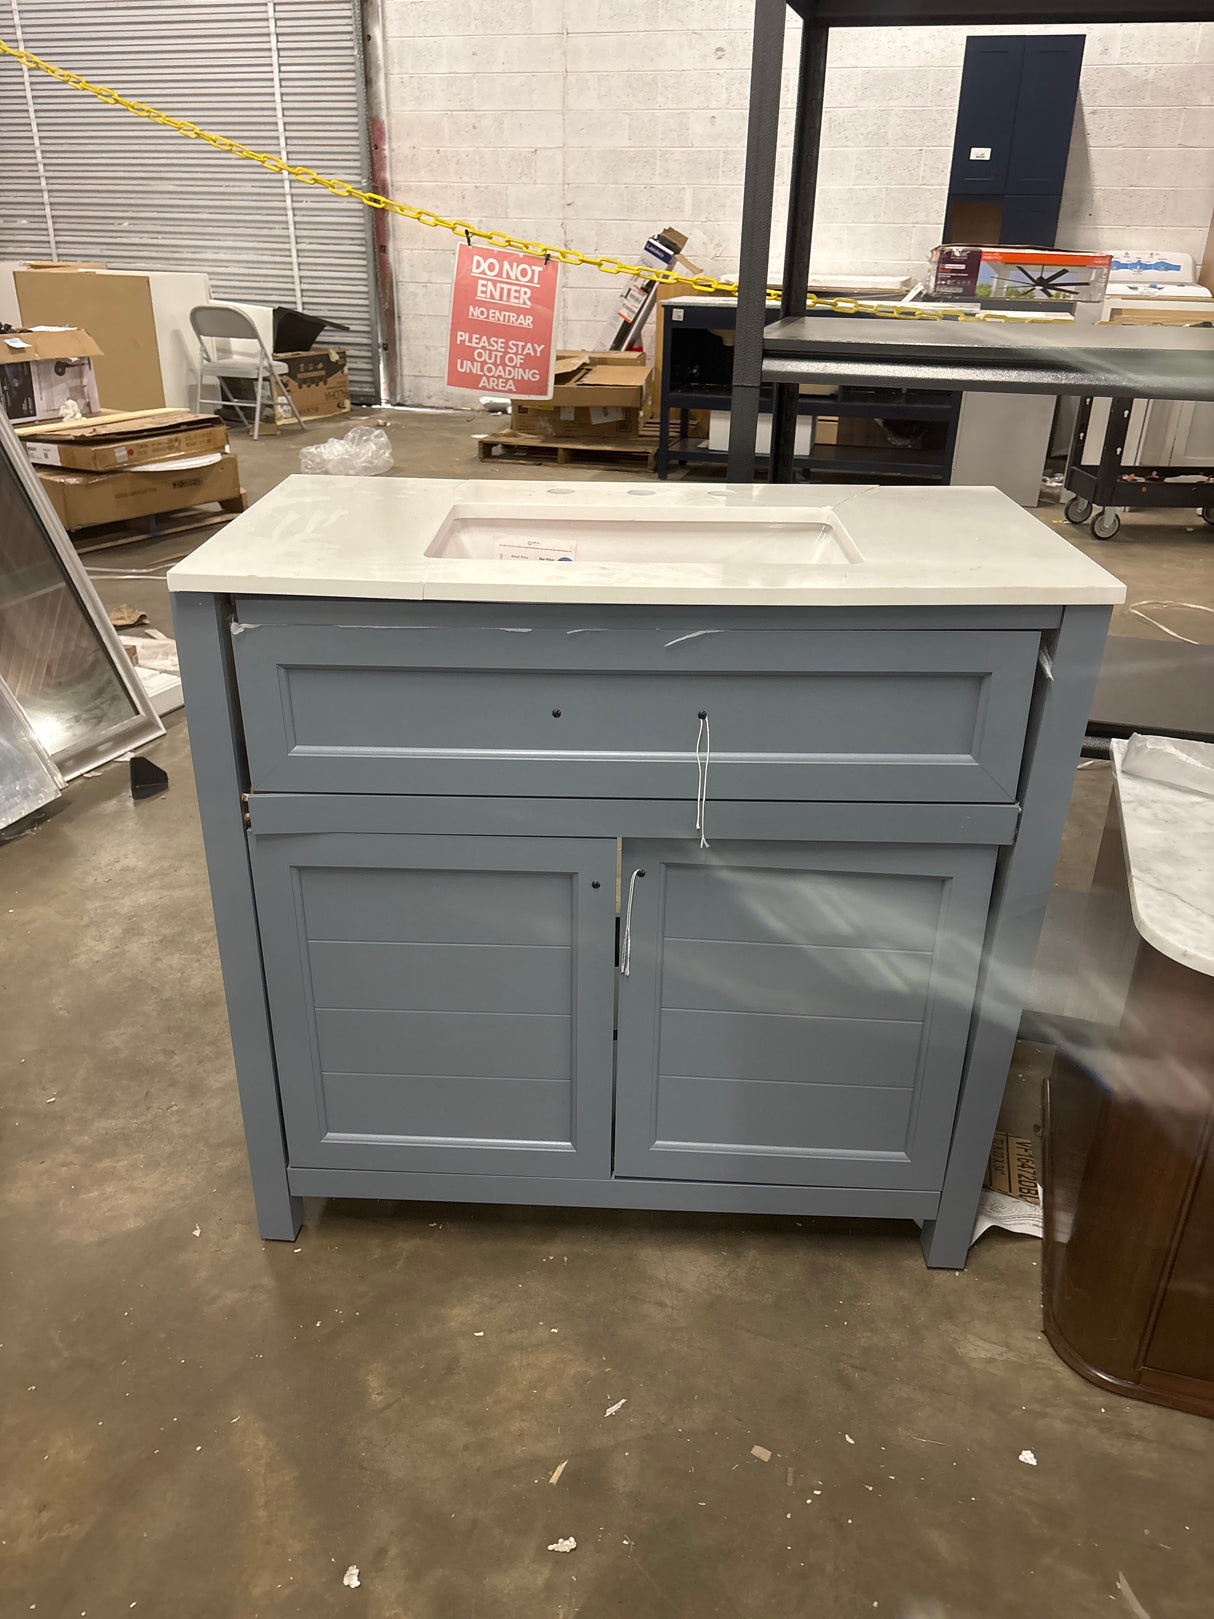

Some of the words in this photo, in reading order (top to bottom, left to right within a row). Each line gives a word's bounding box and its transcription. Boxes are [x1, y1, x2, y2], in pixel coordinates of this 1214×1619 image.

[471, 255, 499, 277] DO
[502, 261, 543, 284] NOT
[476, 279, 532, 306] ENTER
[468, 305, 487, 319] NO
[489, 309, 533, 327] ENTRAR
[456, 331, 505, 351] PLEASE
[507, 340, 544, 357] STAY
[474, 349, 503, 364] OUT
[505, 354, 524, 367] OF
[457, 359, 540, 381] UNLOADING
[478, 376, 516, 392] AREA
